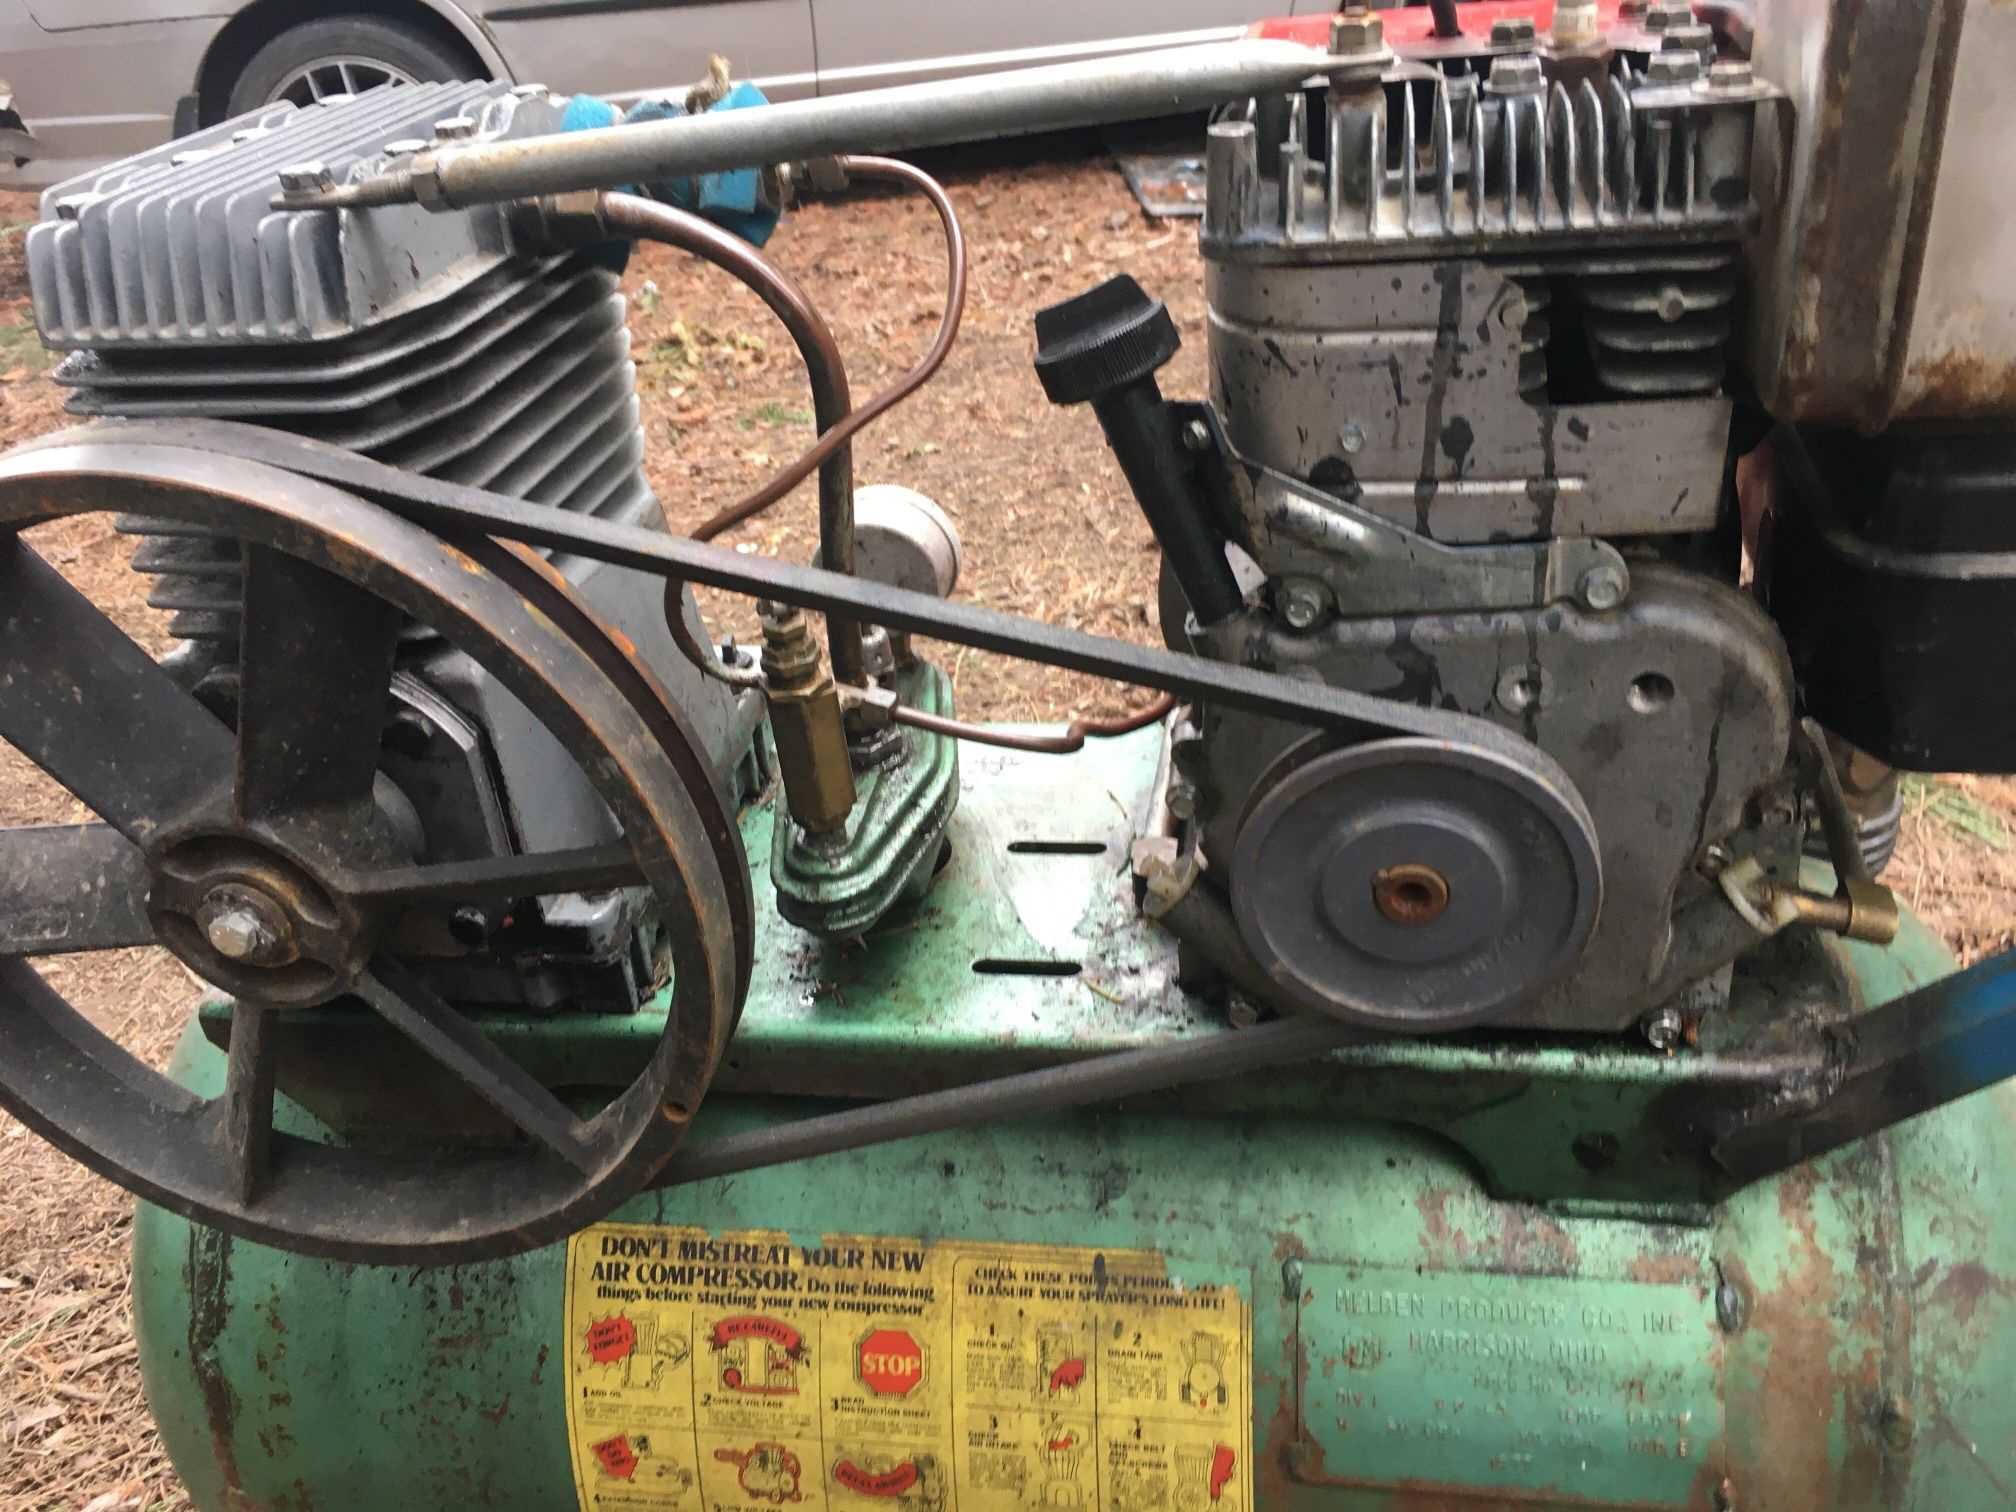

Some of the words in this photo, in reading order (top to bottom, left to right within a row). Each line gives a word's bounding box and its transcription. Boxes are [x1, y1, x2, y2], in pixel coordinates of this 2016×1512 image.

[601, 1237, 668, 1259] DON'T
[678, 1240, 790, 1265] MISTREAT
[802, 1247, 865, 1269] YOUR
[871, 1250, 925, 1272] NEW
[591, 1261, 631, 1282] AIR
[636, 1263, 802, 1291] COMPRESSOR.
[807, 1277, 831, 1294] Do
[835, 1280, 860, 1295] the
[863, 1281, 935, 1303] following
[597, 1285, 642, 1303] things
[645, 1287, 693, 1302] before
[697, 1290, 757, 1309] starting
[762, 1297, 793, 1310] your
[799, 1298, 830, 1310] new
[834, 1300, 925, 1316] compressor
[1440, 1296, 1564, 1328] PRODUCTS
[862, 1352, 921, 1377] STOP
[1550, 1339, 1606, 1364] OHIO
